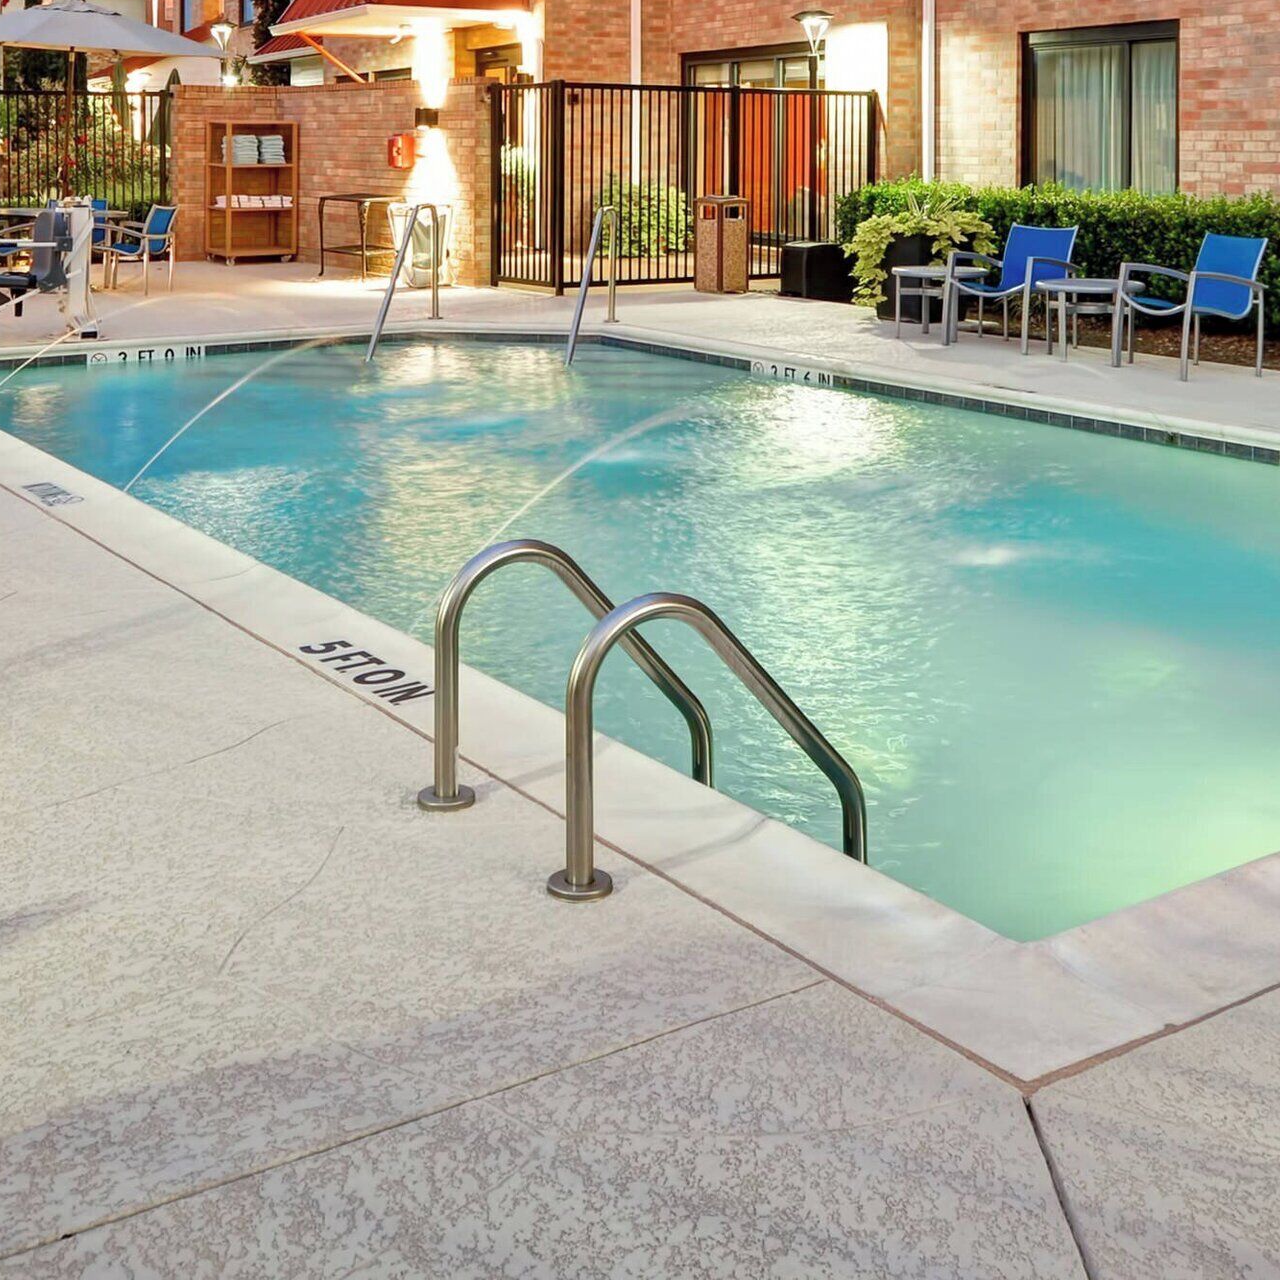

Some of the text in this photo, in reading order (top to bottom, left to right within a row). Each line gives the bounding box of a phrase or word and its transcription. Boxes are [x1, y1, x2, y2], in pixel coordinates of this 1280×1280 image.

[138, 349, 155, 361] FT
[185, 345, 201, 357] IN
[299, 640, 353, 654] 5
